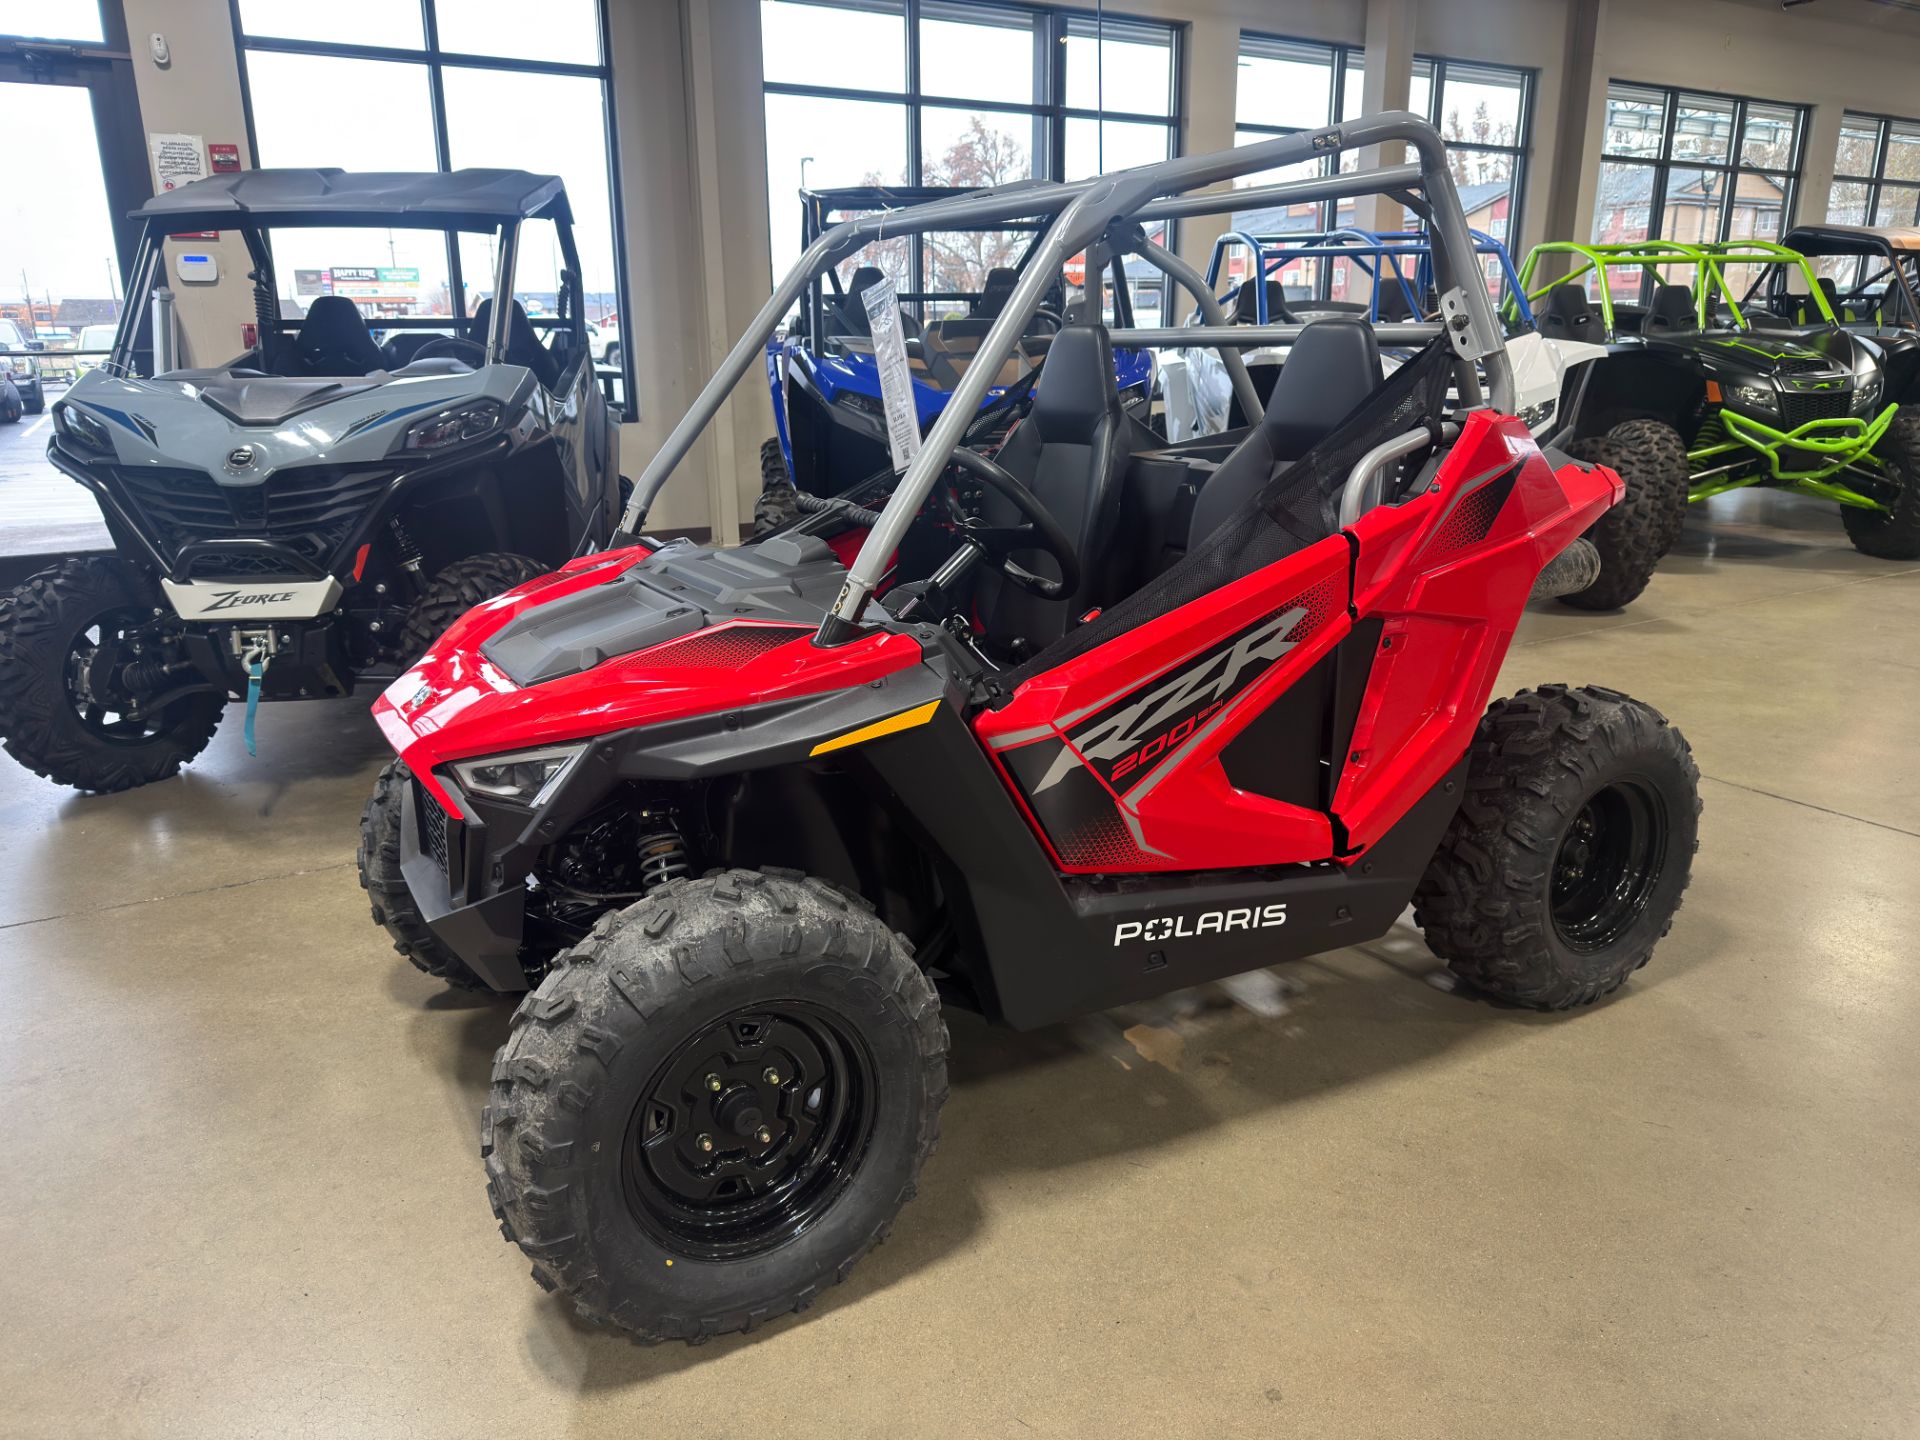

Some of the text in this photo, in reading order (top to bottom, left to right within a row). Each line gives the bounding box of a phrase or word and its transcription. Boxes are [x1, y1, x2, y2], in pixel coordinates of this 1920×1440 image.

[333, 268, 357, 278] HAPPY
[199, 590, 299, 613] ZFORCE
[1032, 607, 1310, 796] RZR
[1111, 715, 1196, 782] 200
[1114, 903, 1287, 947] POLARIS
